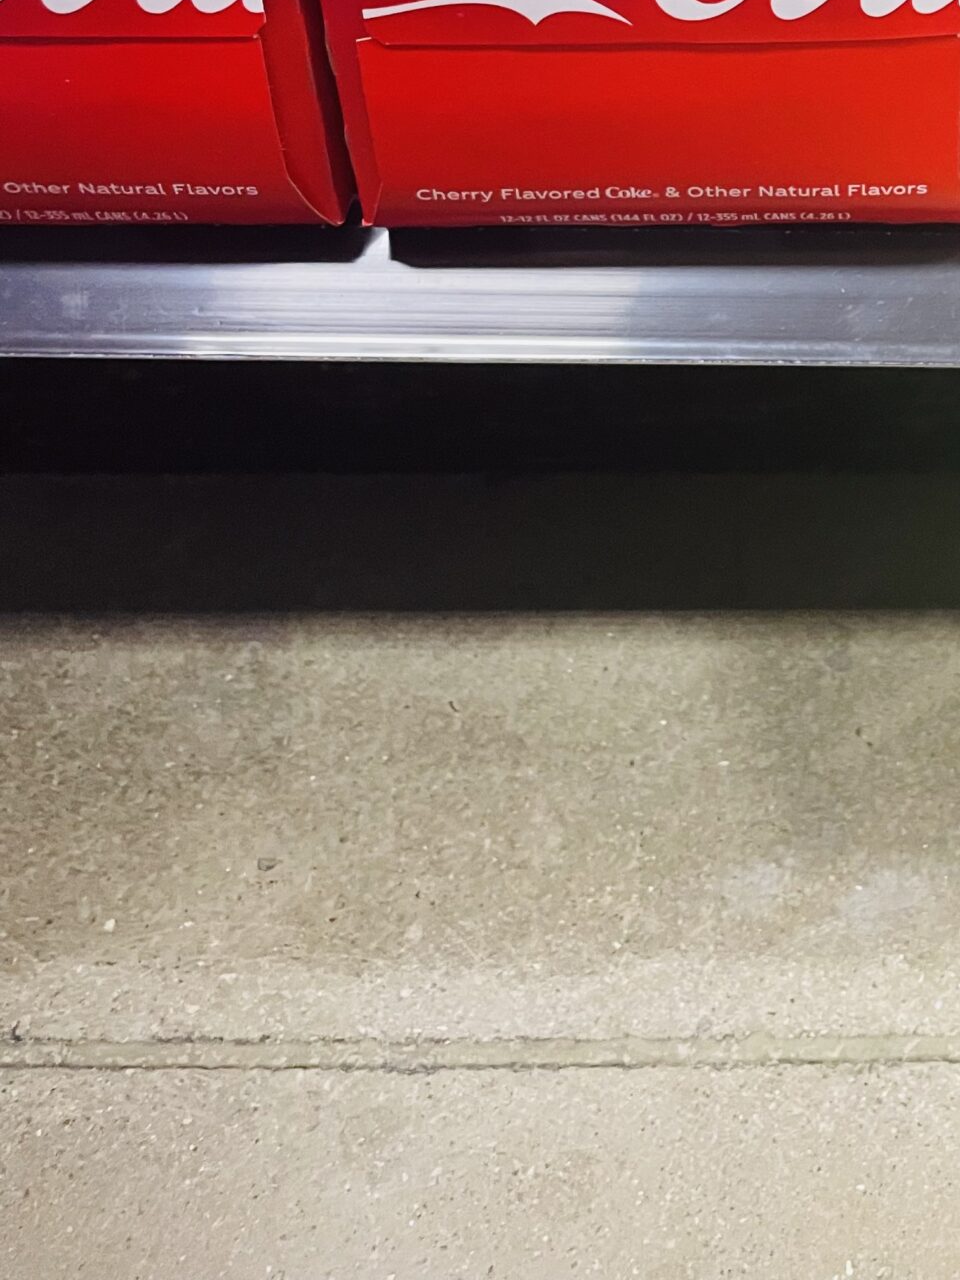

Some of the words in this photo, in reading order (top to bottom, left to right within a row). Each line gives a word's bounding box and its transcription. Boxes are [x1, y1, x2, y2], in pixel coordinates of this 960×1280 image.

[3, 182, 71, 195] Other
[78, 182, 167, 196] Natural
[172, 183, 259, 197] Flavors
[416, 188, 493, 203] Cherry
[501, 187, 600, 200] Flavored
[665, 187, 680, 198] &
[688, 185, 751, 198] Other
[758, 184, 840, 197] Natural
[848, 183, 928, 197] Flavors
[763, 212, 797, 221] CANS
